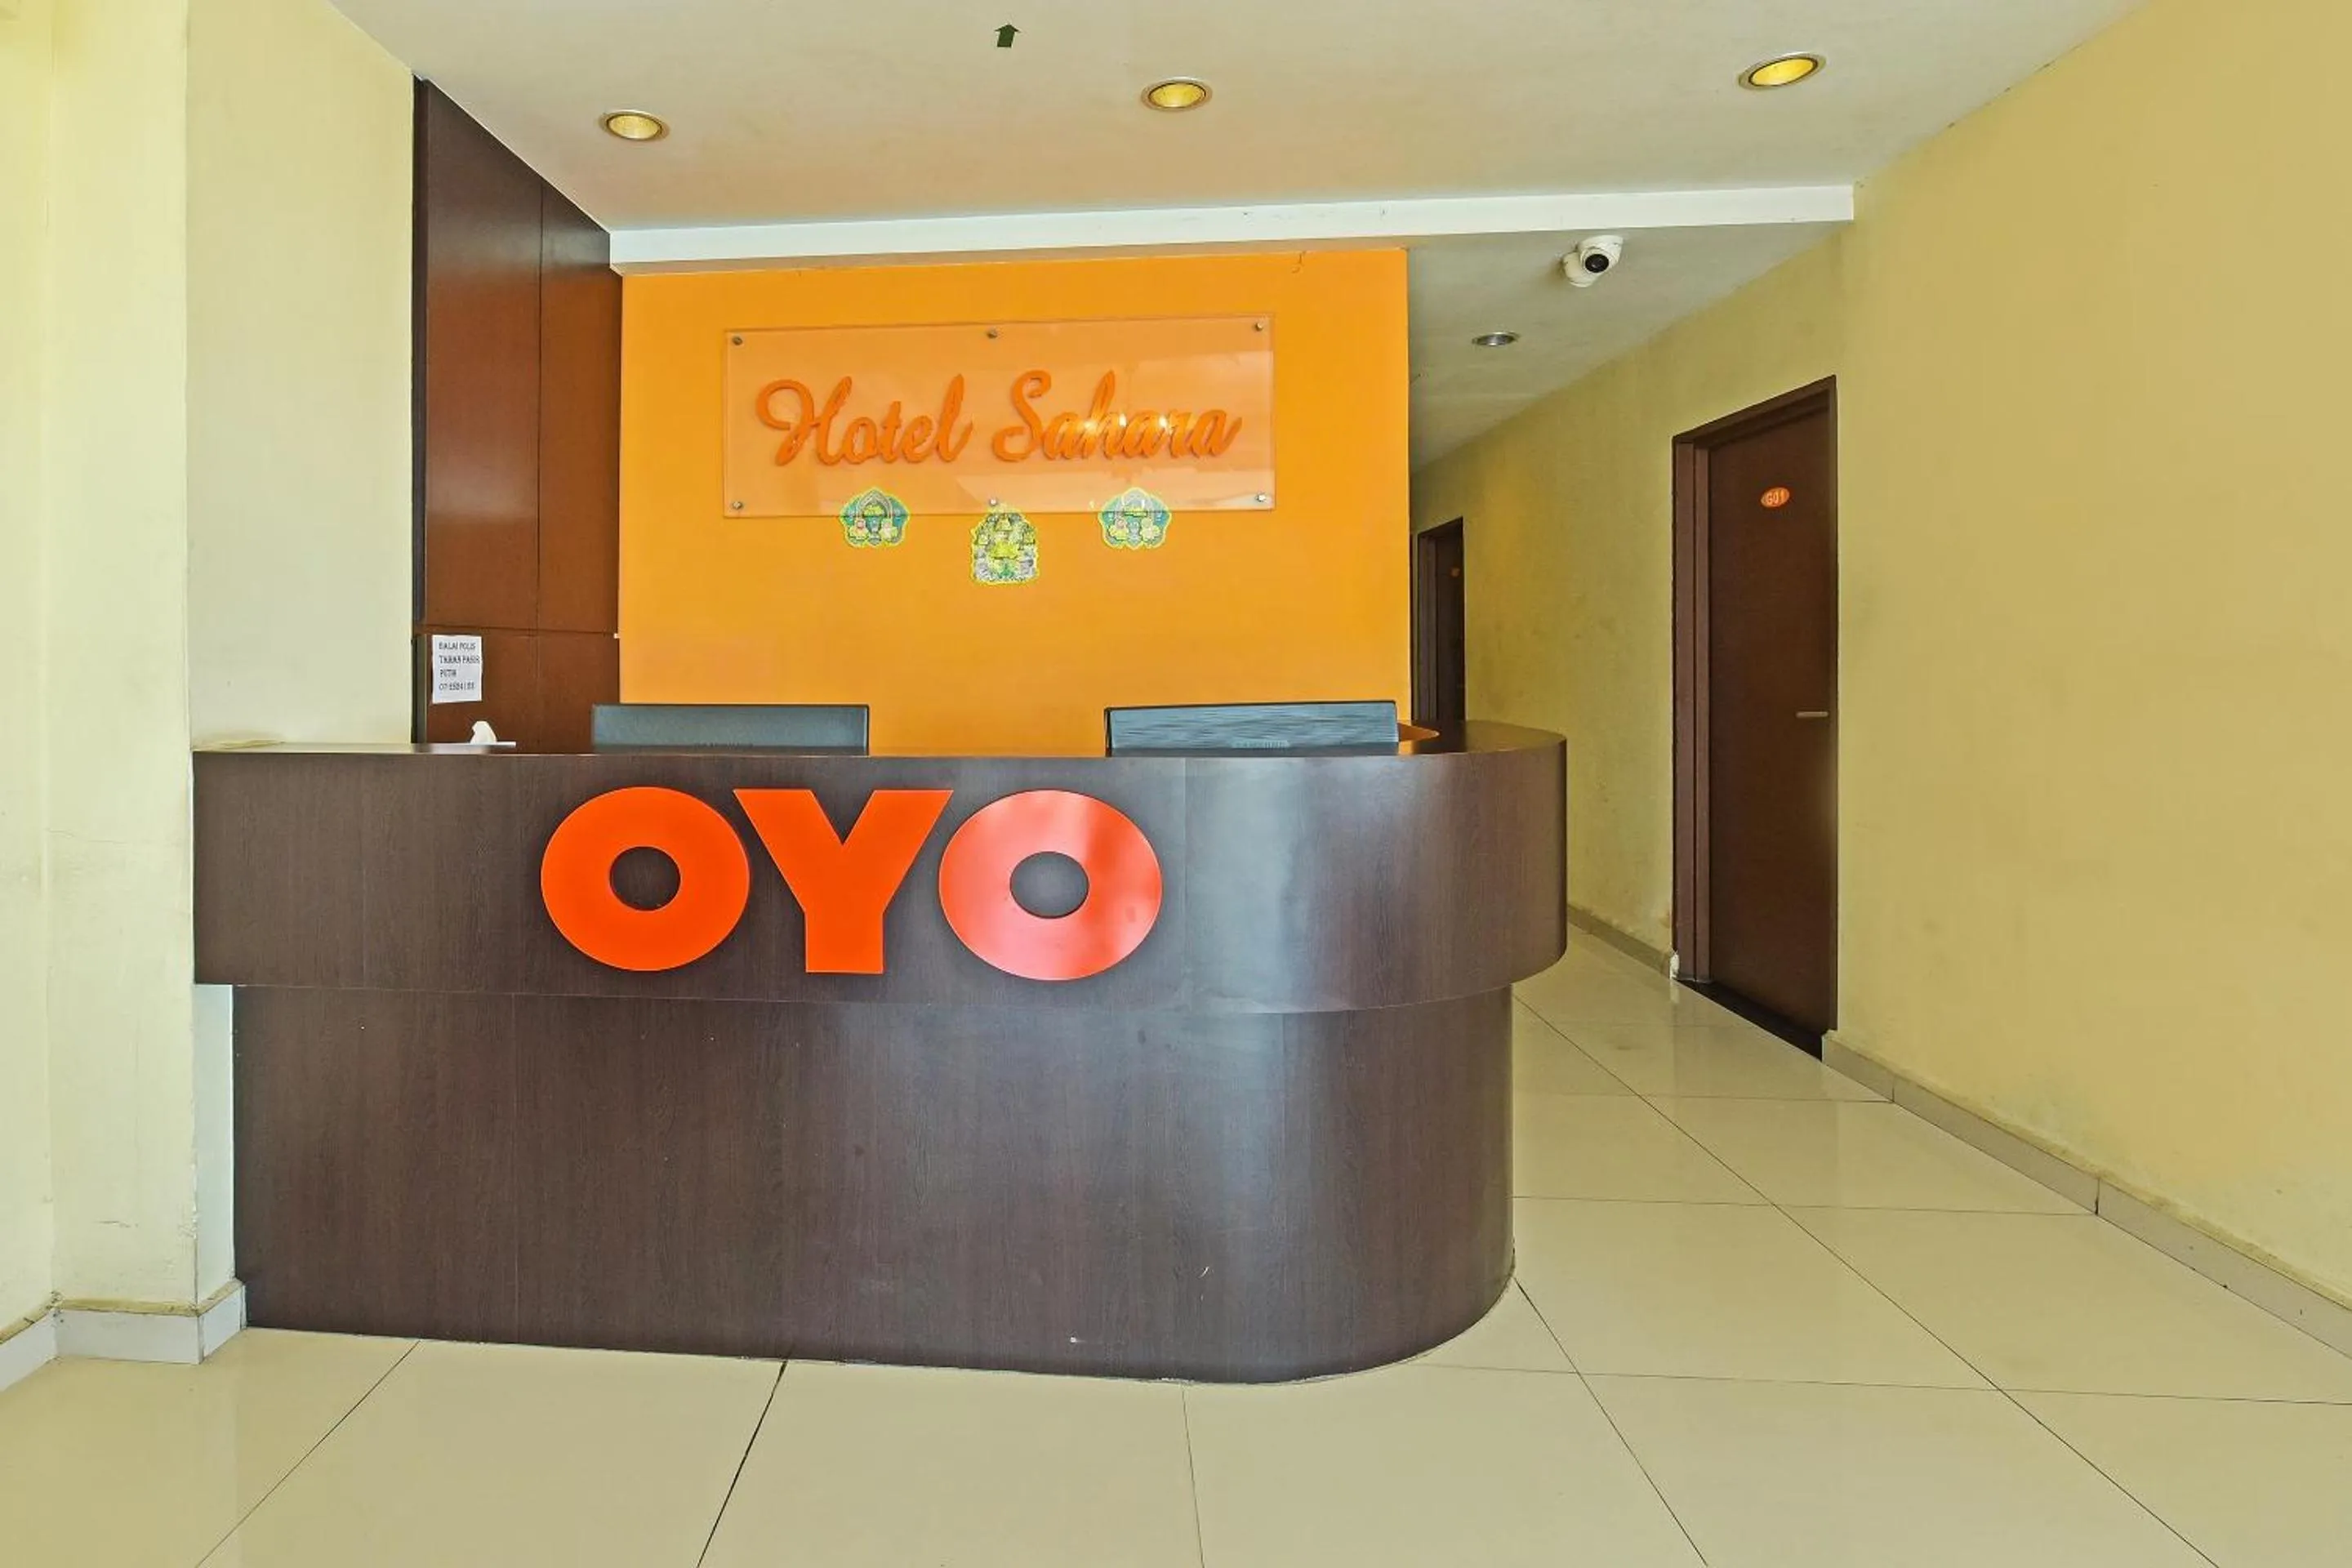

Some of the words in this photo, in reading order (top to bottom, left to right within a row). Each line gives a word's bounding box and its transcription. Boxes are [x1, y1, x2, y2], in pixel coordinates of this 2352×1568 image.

[755, 374, 973, 467] Hotel
[992, 369, 1243, 462] Sahara
[541, 786, 1163, 981] OYO
